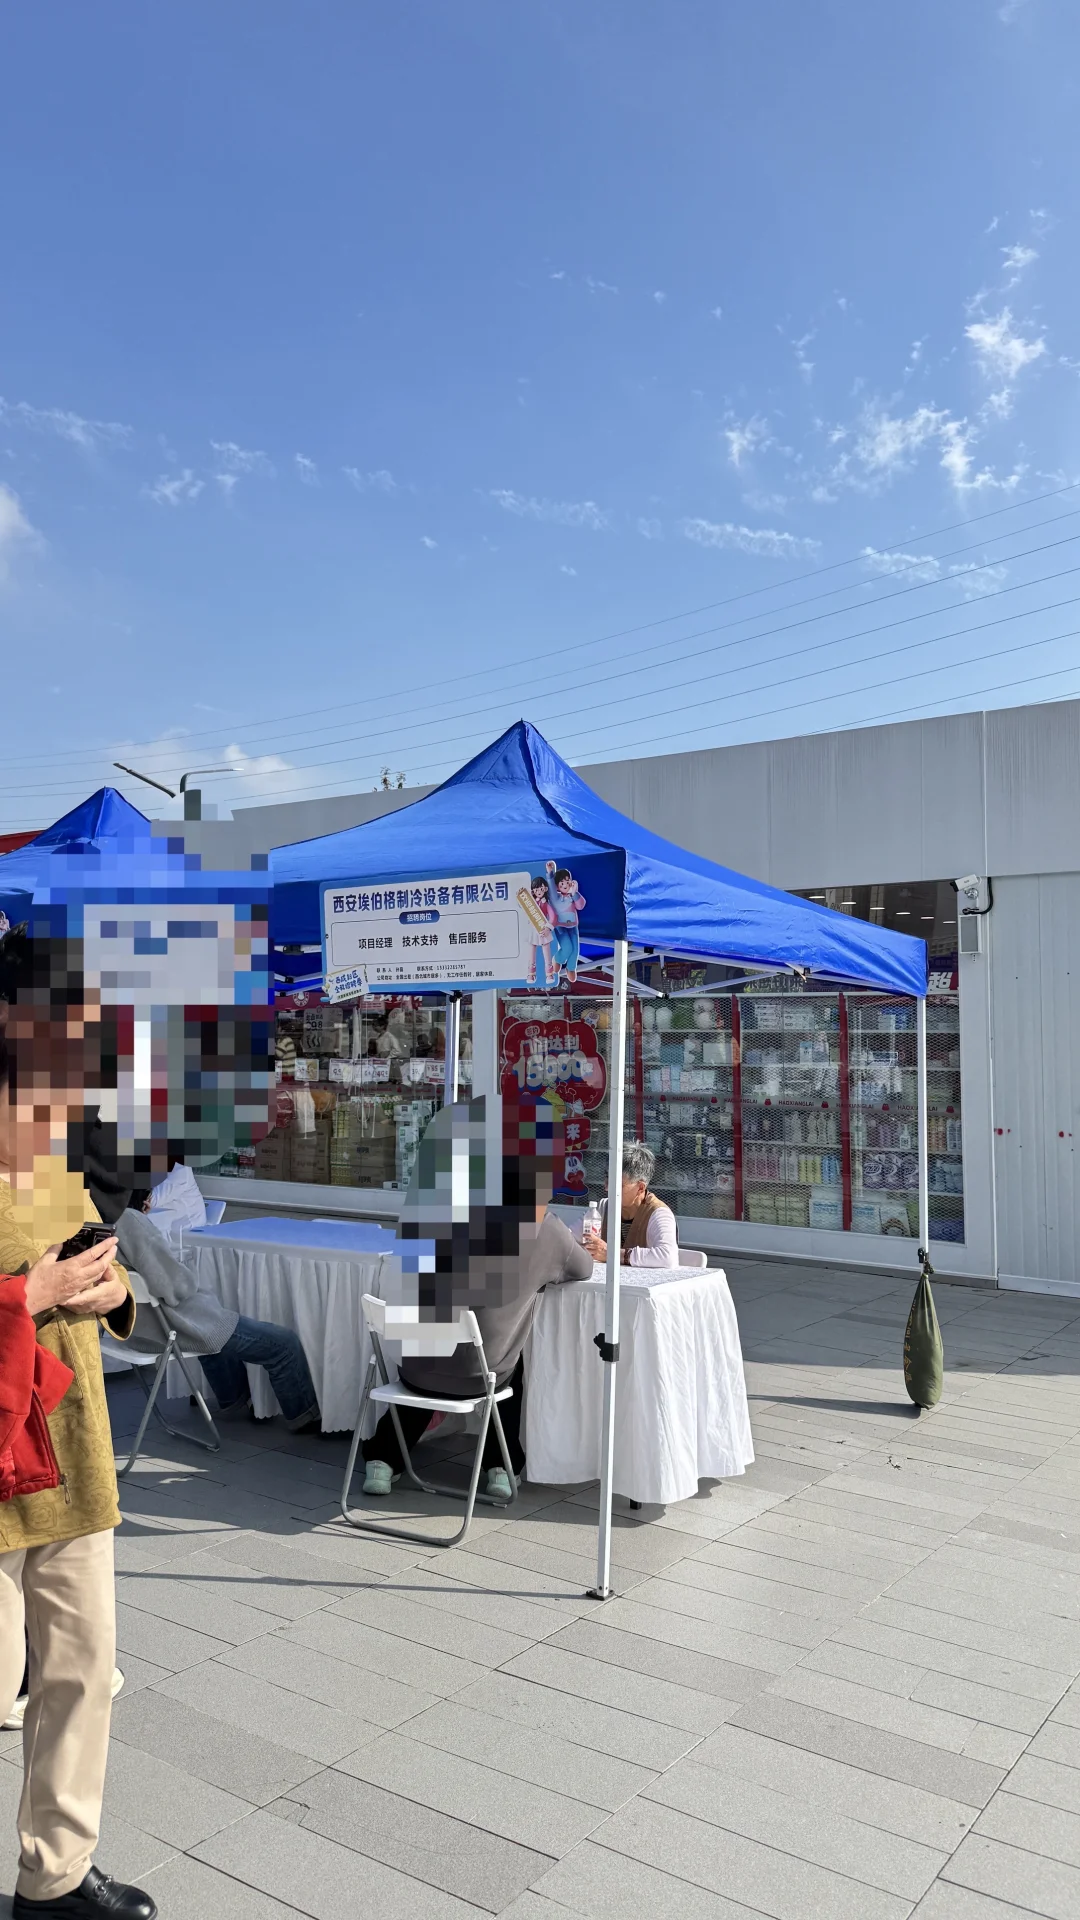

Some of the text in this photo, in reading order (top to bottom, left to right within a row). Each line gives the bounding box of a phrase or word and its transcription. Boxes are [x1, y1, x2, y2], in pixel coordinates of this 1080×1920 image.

[333, 882, 509, 914] 西安埃伯格制冷设备有限公司
[406, 912, 433, 923] 招聘岗位
[358, 931, 487, 950] 项目经理 技术支持 售后服务
